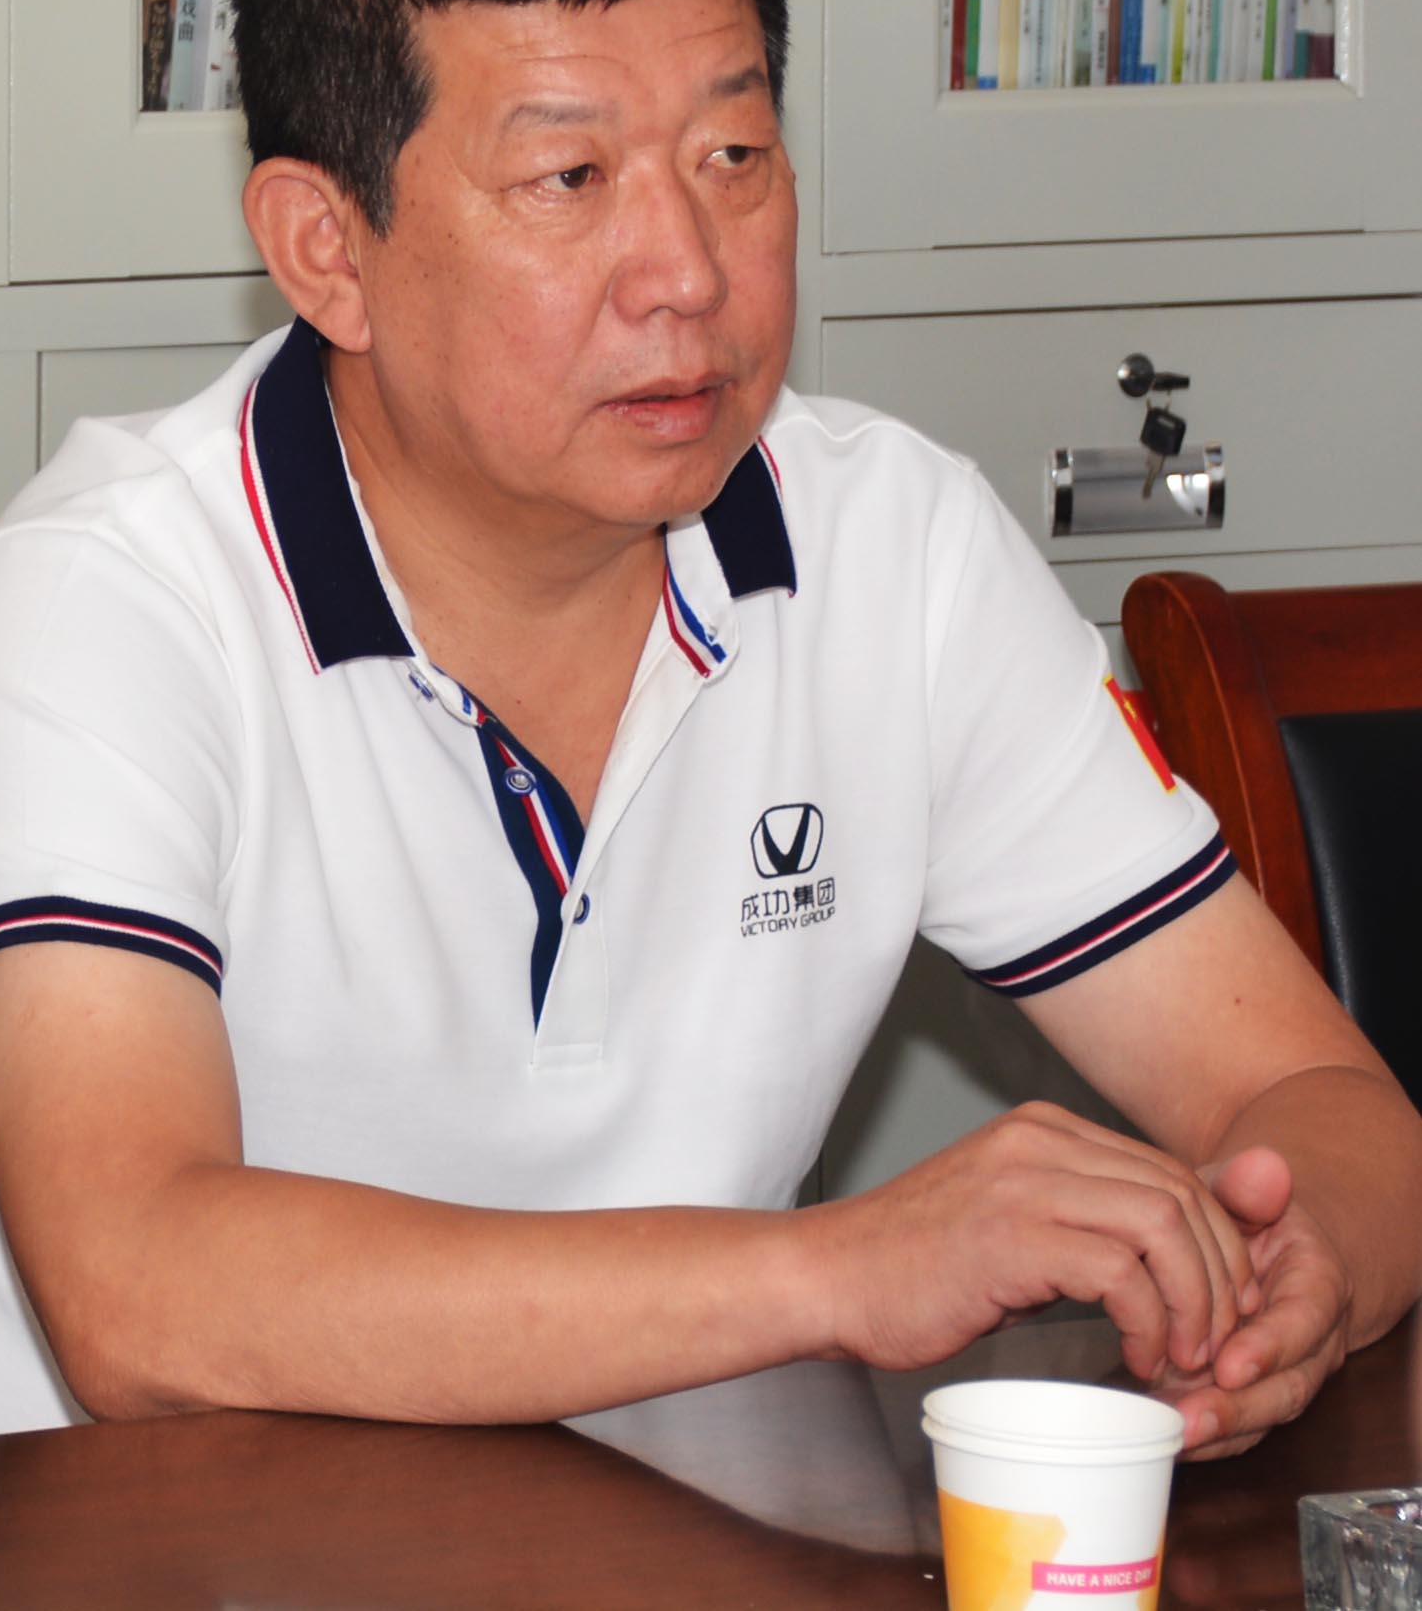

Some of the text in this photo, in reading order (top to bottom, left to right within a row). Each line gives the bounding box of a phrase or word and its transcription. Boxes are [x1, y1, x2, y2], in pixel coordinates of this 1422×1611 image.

[740, 876, 836, 923] 成功集团
[1046, 1572, 1085, 1587] HAVE
[1089, 1574, 1100, 1587] A
[1103, 1572, 1133, 1587] NICE
